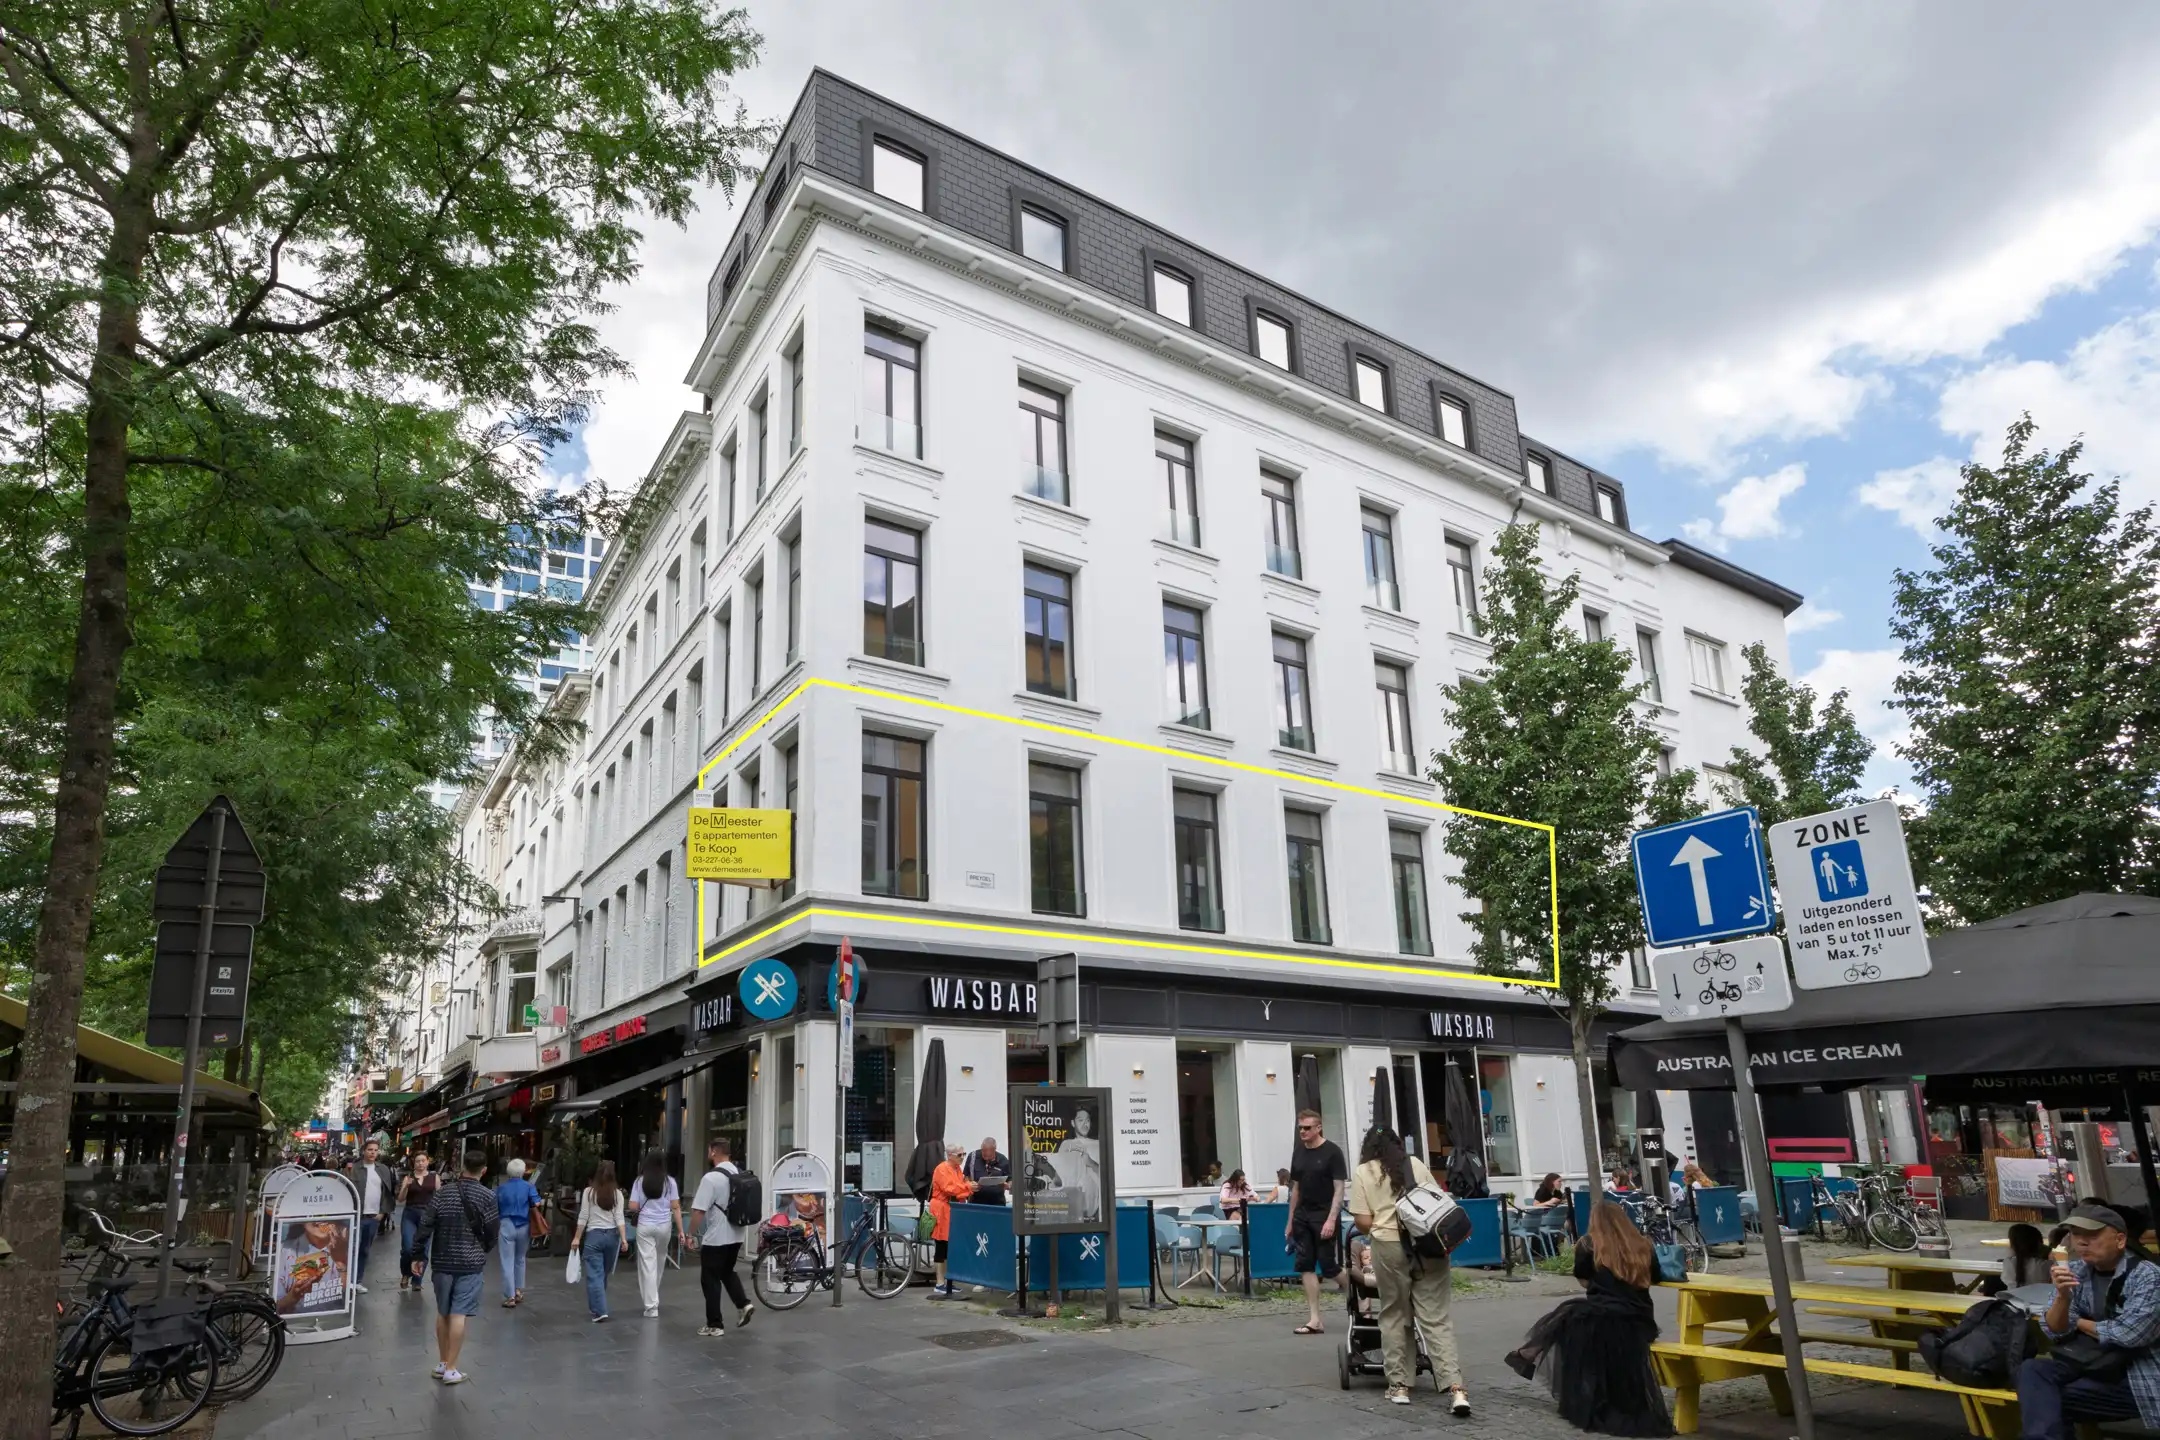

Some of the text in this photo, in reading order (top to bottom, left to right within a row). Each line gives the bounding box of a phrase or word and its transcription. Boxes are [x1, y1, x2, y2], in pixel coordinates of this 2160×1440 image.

[693, 814, 763, 827] De Meester
[694, 831, 778, 841] 6 appartementen
[1794, 814, 1870, 848] ZONE
[694, 843, 737, 855] Te Koop
[692, 856, 743, 864] 03-227-06-36
[692, 866, 762, 874] www.demeester.eu
[1803, 895, 1892, 919] Uitgezonderd
[1799, 911, 1903, 934] laden en lossen
[1797, 925, 1912, 950] van 5 u tot 11 uur
[1827, 949, 1860, 961] Max.
[930, 977, 1037, 1013] WASBAR
[694, 995, 731, 1031] WASBAR
[1721, 1005, 1727, 1013] P
[1430, 1012, 1494, 1038] WASBAR
[1657, 1043, 1903, 1072] AUSTRAAN ICE CREAM
[1972, 1073, 2083, 1088] AUSTRALIAN
[2088, 1072, 2120, 1084] ICE
[1025, 1100, 1053, 1113] Niall
[1025, 1113, 1062, 1126] Horan
[1025, 1125, 1067, 1139] Dinner
[1648, 1140, 1657, 1150] A
[302, 1194, 334, 1203] WASBAR
[311, 1277, 344, 1291] BAGEL
[303, 1285, 343, 1302] BURGER
